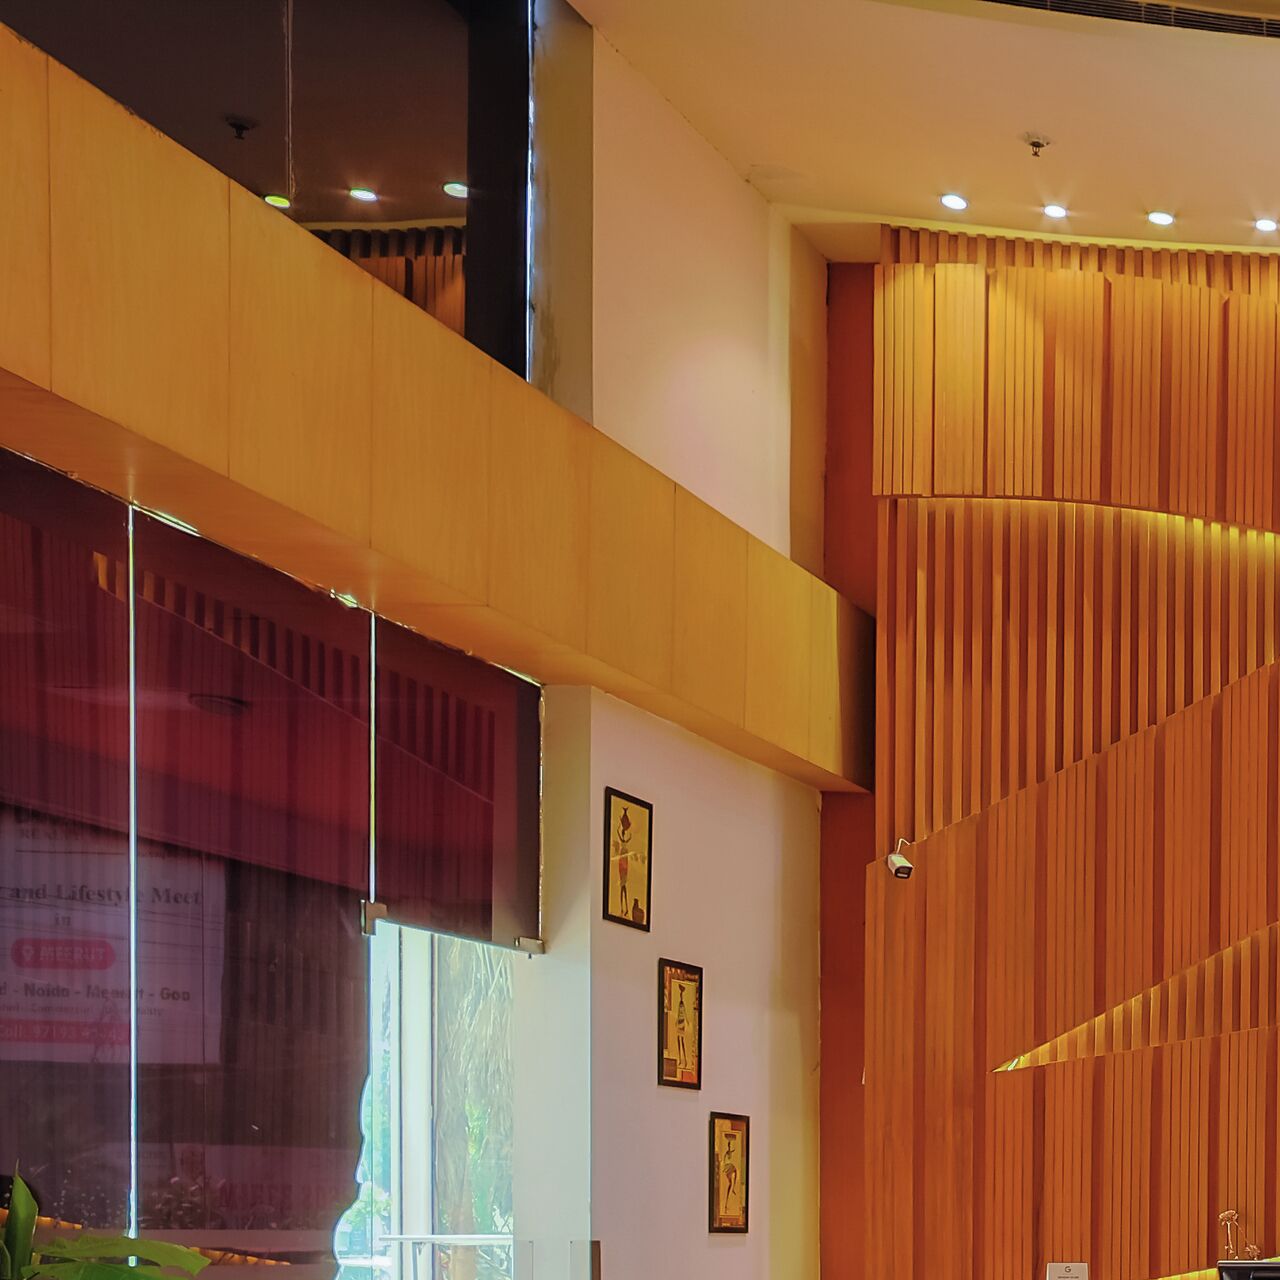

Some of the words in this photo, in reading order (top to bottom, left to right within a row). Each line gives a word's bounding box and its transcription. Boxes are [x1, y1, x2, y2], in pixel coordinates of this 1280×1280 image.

[8, 884, 47, 900] and
[151, 887, 202, 904] Meet
[24, 982, 70, 998] Noida
[86, 984, 144, 1000] Meert
[160, 986, 191, 1001] Goa
